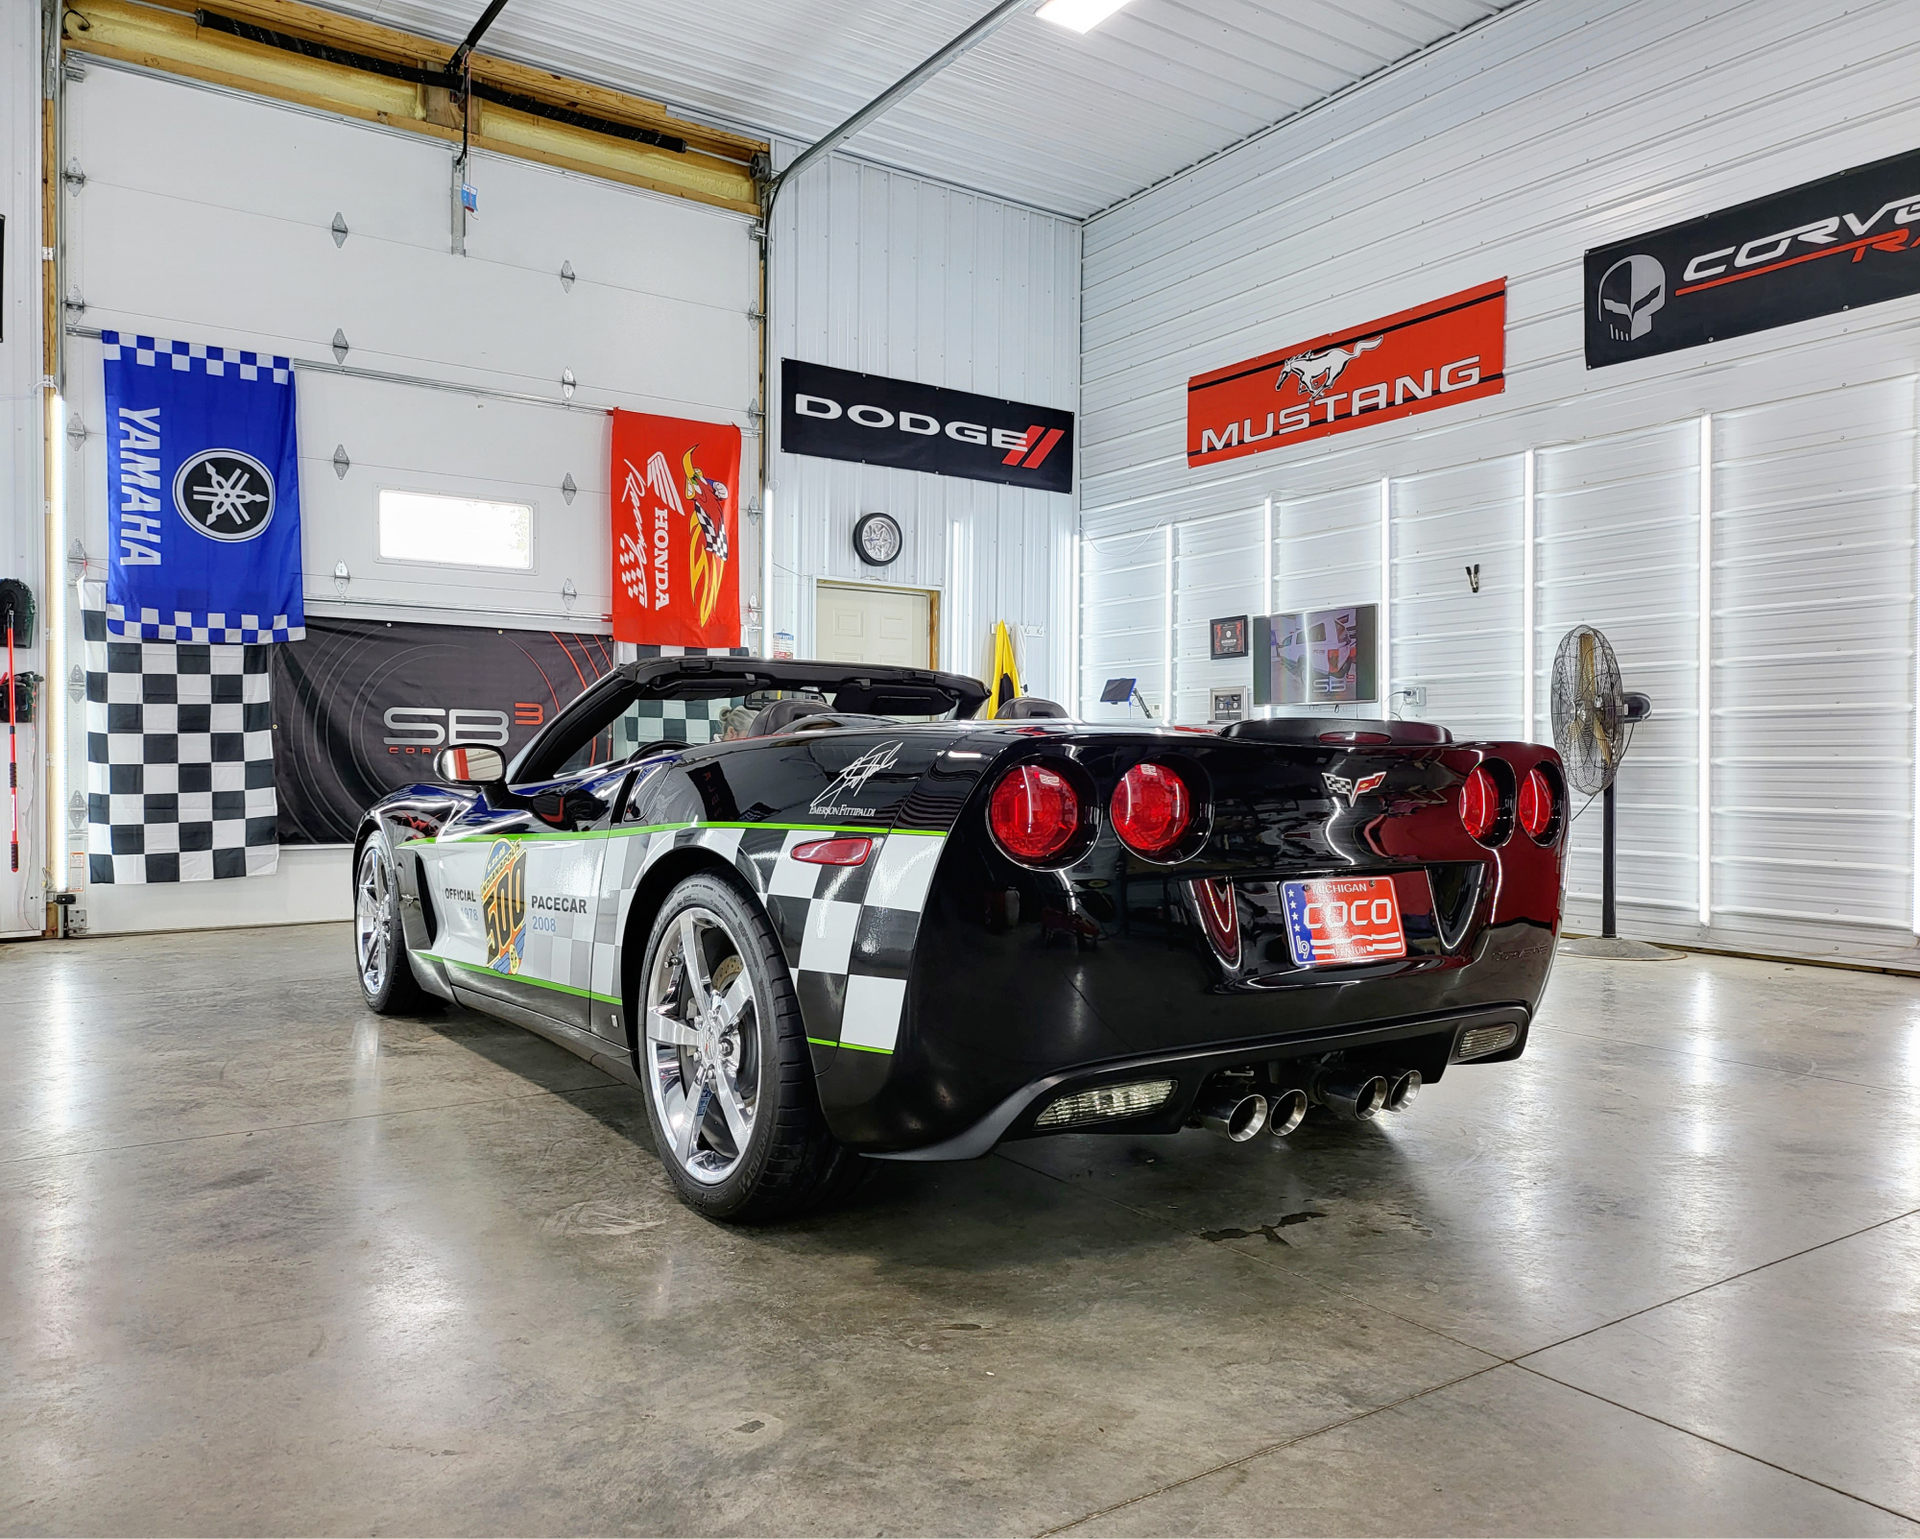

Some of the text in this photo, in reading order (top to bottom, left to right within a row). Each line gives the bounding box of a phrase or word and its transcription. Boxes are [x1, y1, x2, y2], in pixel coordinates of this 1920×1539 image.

[795, 393, 1028, 452] DODGE
[1201, 355, 1481, 454] MUSTANG
[118, 406, 162, 566] YAMAHA
[654, 506, 670, 611] HONDA
[388, 746, 444, 755] COA
[445, 887, 477, 902] OFFICIAL
[482, 849, 526, 967] 500
[531, 895, 588, 915] PACECAR
[1303, 899, 1392, 929] COCO
[532, 916, 557, 933] 2008
